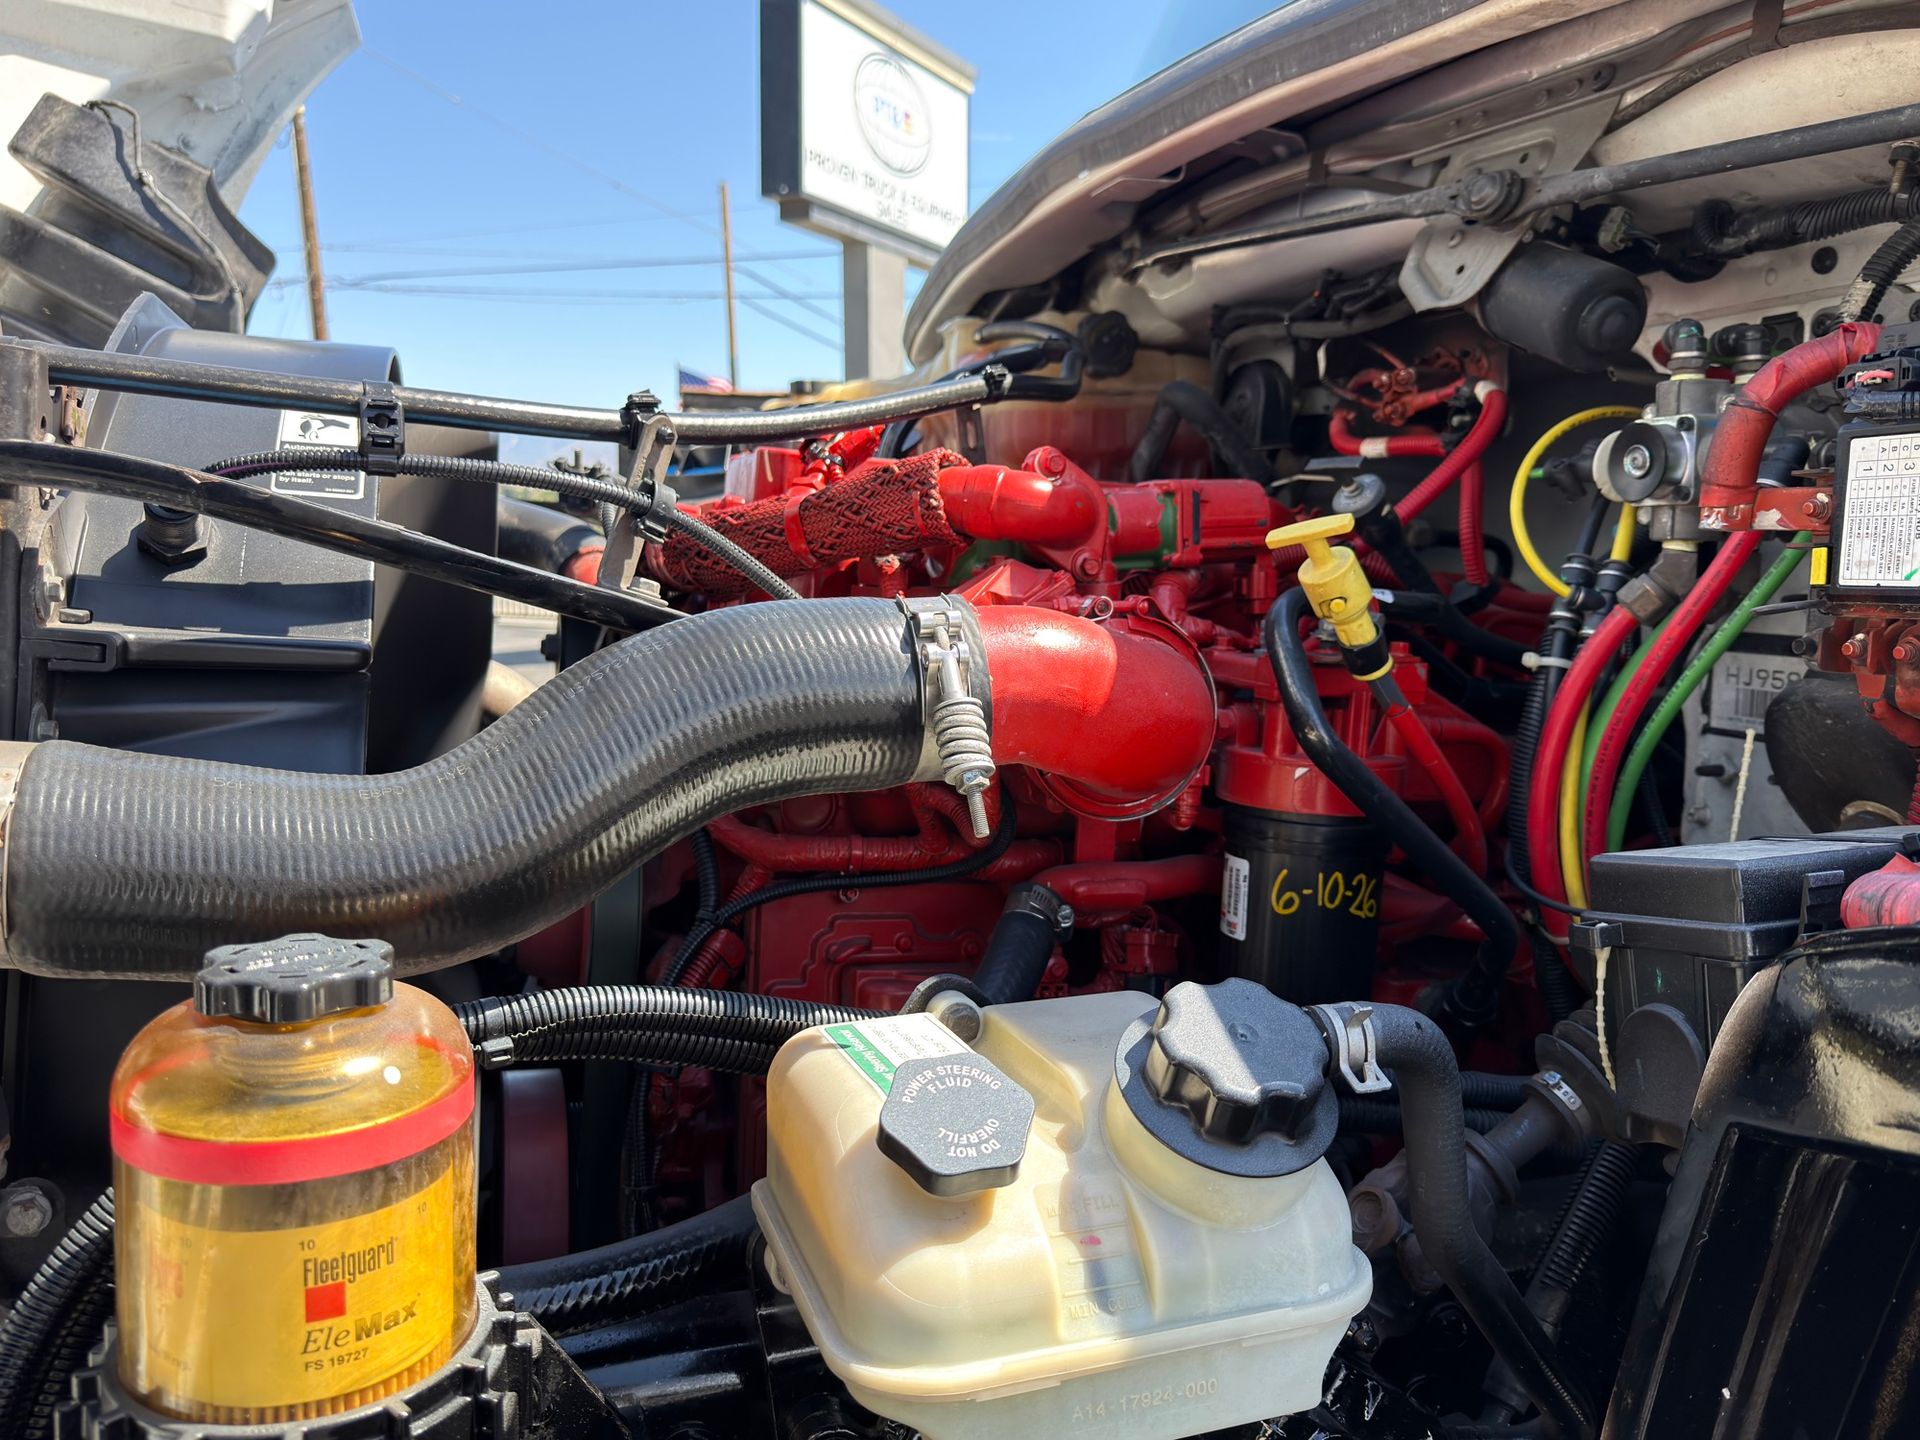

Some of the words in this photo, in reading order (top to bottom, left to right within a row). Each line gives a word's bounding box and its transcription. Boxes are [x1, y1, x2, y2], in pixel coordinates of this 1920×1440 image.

[1883, 464, 1894, 472] 2
[1904, 462, 1915, 470] 3
[297, 471, 320, 479] starts
[1270, 868, 1377, 919] 6-10-26
[902, 1069, 936, 1104] POWER
[936, 1064, 1002, 1090] STEERING
[928, 1076, 972, 1094] FLUID
[938, 1118, 1000, 1144] OVERFILL
[947, 1145, 978, 1158] NOT
[982, 1139, 1001, 1154] DO
[298, 1239, 316, 1251] 10
[303, 1236, 395, 1287] Fleetguard
[304, 1359, 324, 1372] FS
[330, 1347, 369, 1368] 19727
